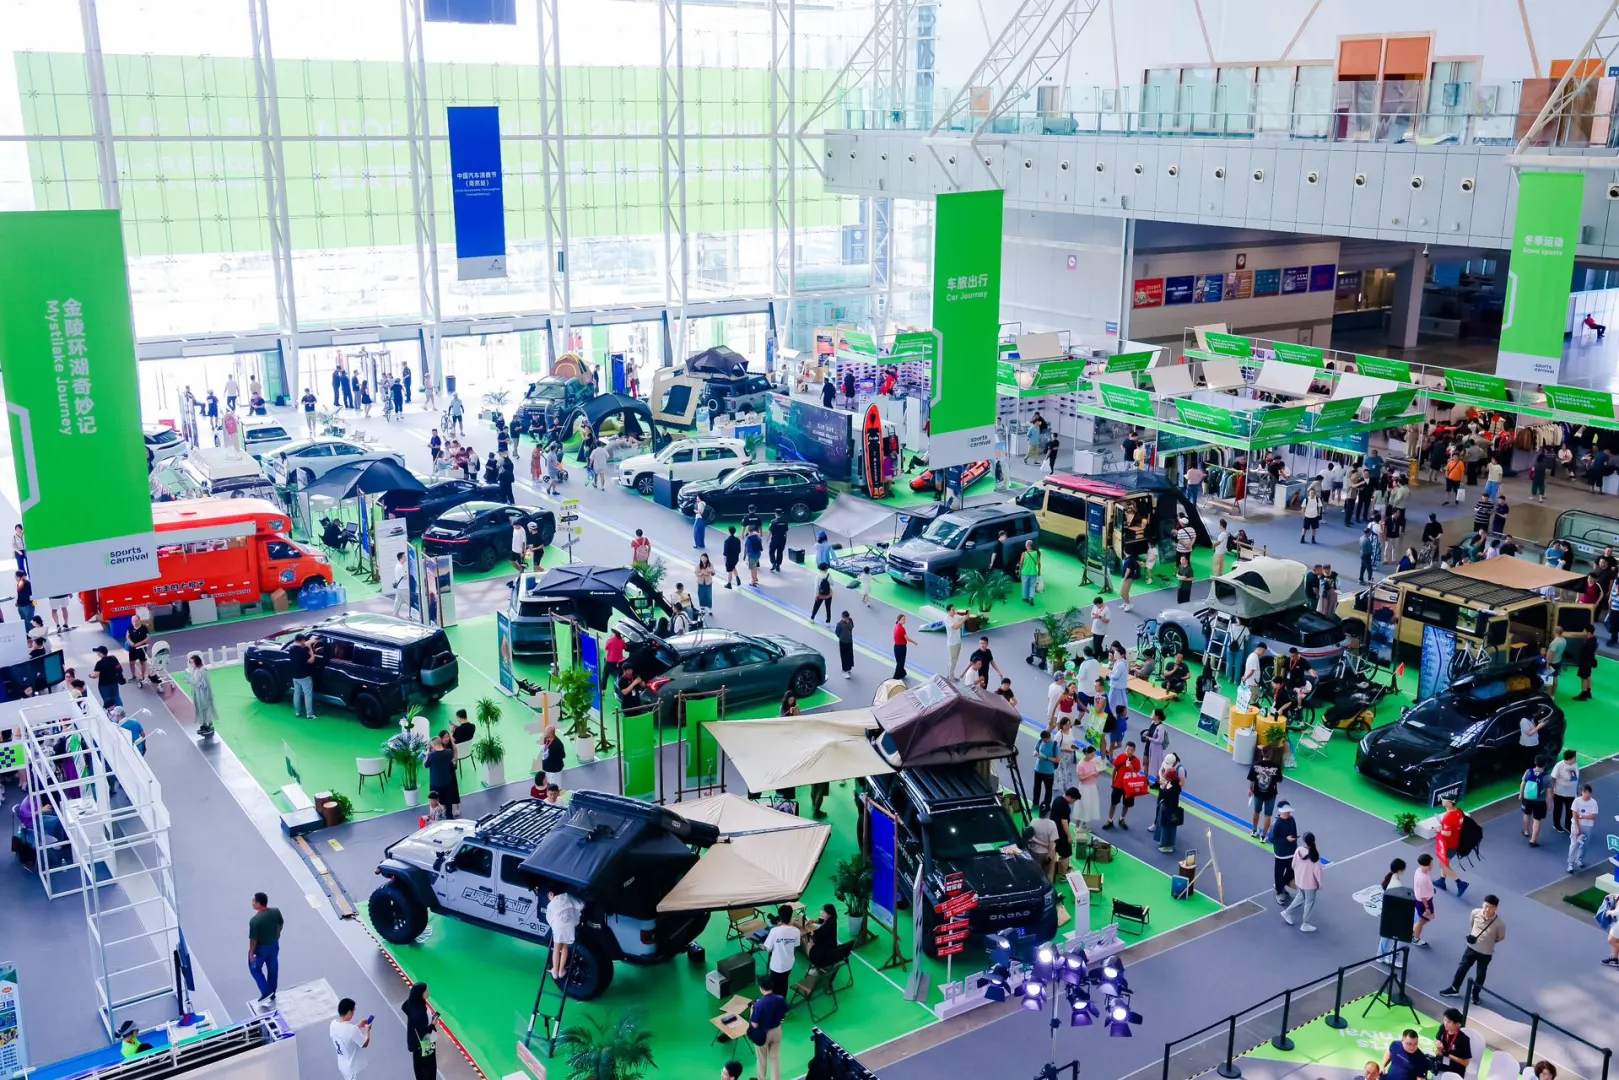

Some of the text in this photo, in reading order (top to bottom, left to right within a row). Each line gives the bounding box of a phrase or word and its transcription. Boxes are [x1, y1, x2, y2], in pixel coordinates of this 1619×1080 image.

[1524, 235, 1564, 247] 冬季运动
[946, 273, 988, 290] 车旅出行
[946, 291, 988, 302] Car Journey
[44, 299, 72, 435] Mystilake Journey
[62, 298, 97, 434] 金陵环湖奇妙记
[970, 440, 991, 448] carnival
[110, 546, 142, 558] sports
[110, 552, 149, 565] carnival
